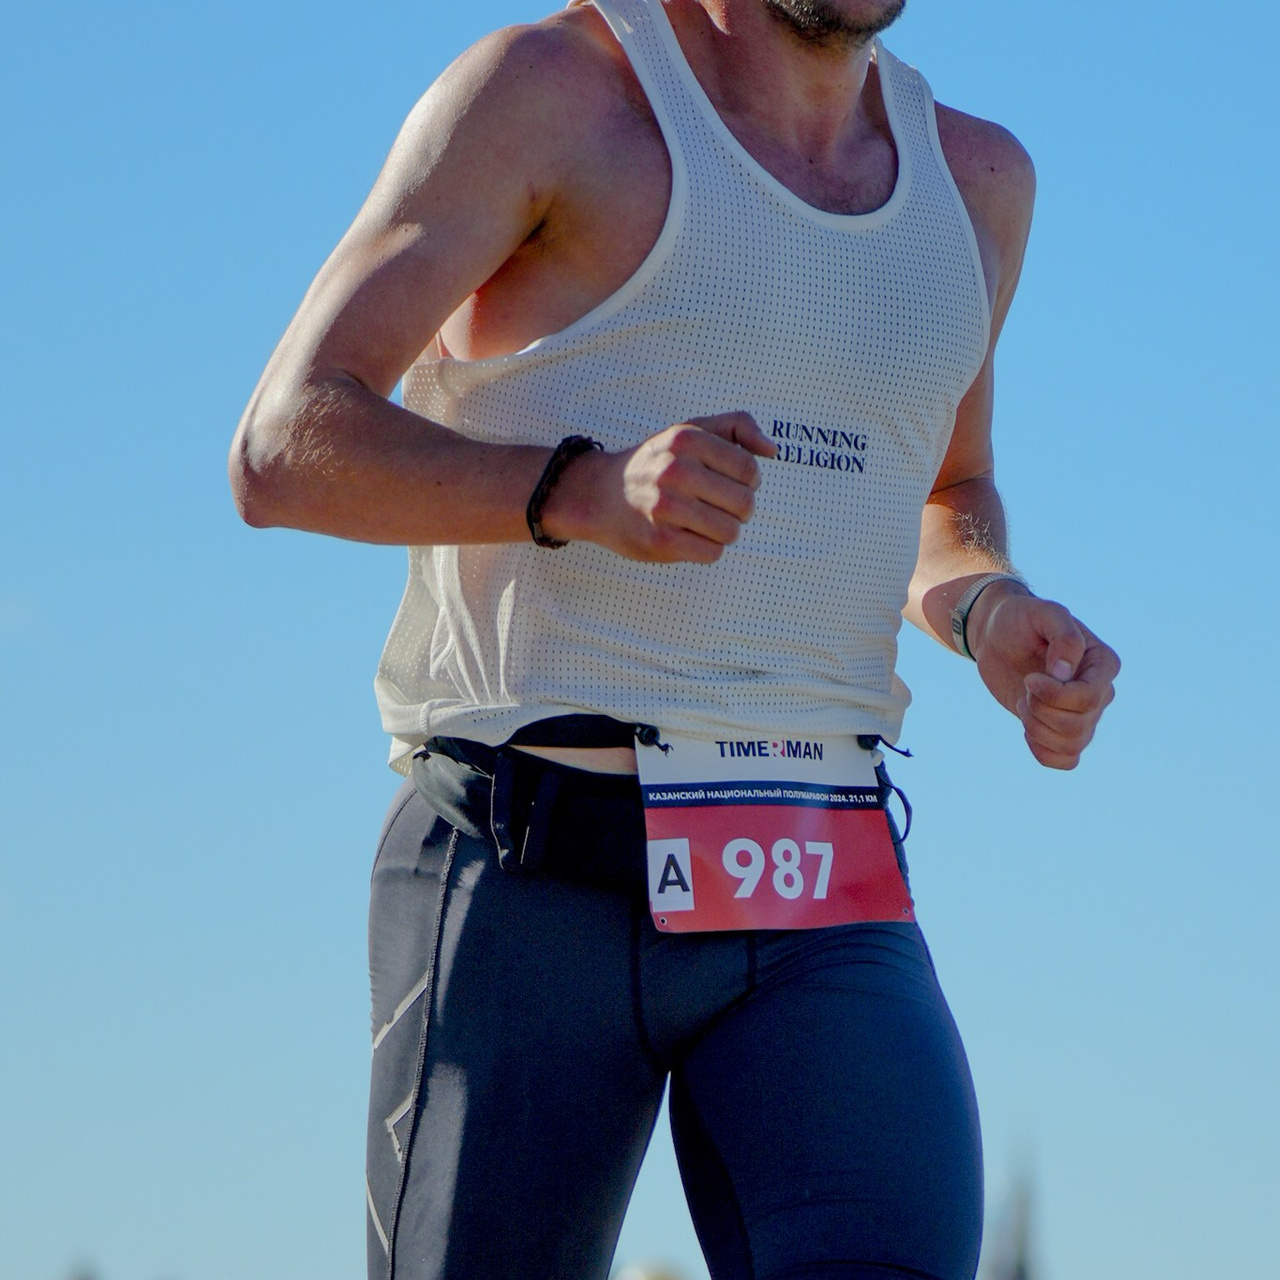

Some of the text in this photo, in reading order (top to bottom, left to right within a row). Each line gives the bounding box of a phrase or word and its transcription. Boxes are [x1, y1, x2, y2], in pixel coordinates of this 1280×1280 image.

[771, 419, 867, 451] RUNNING
[648, 789, 705, 801] КАЗАНСКИЙ
[706, 787, 782, 800] НАЦИОНАЛЬНЫЙ
[783, 789, 830, 801] ПОЛУМАРАФОН
[849, 794, 865, 804] 21,1
[865, 794, 878, 803] КМ
[657, 853, 691, 894] A
[722, 837, 834, 900] 987
